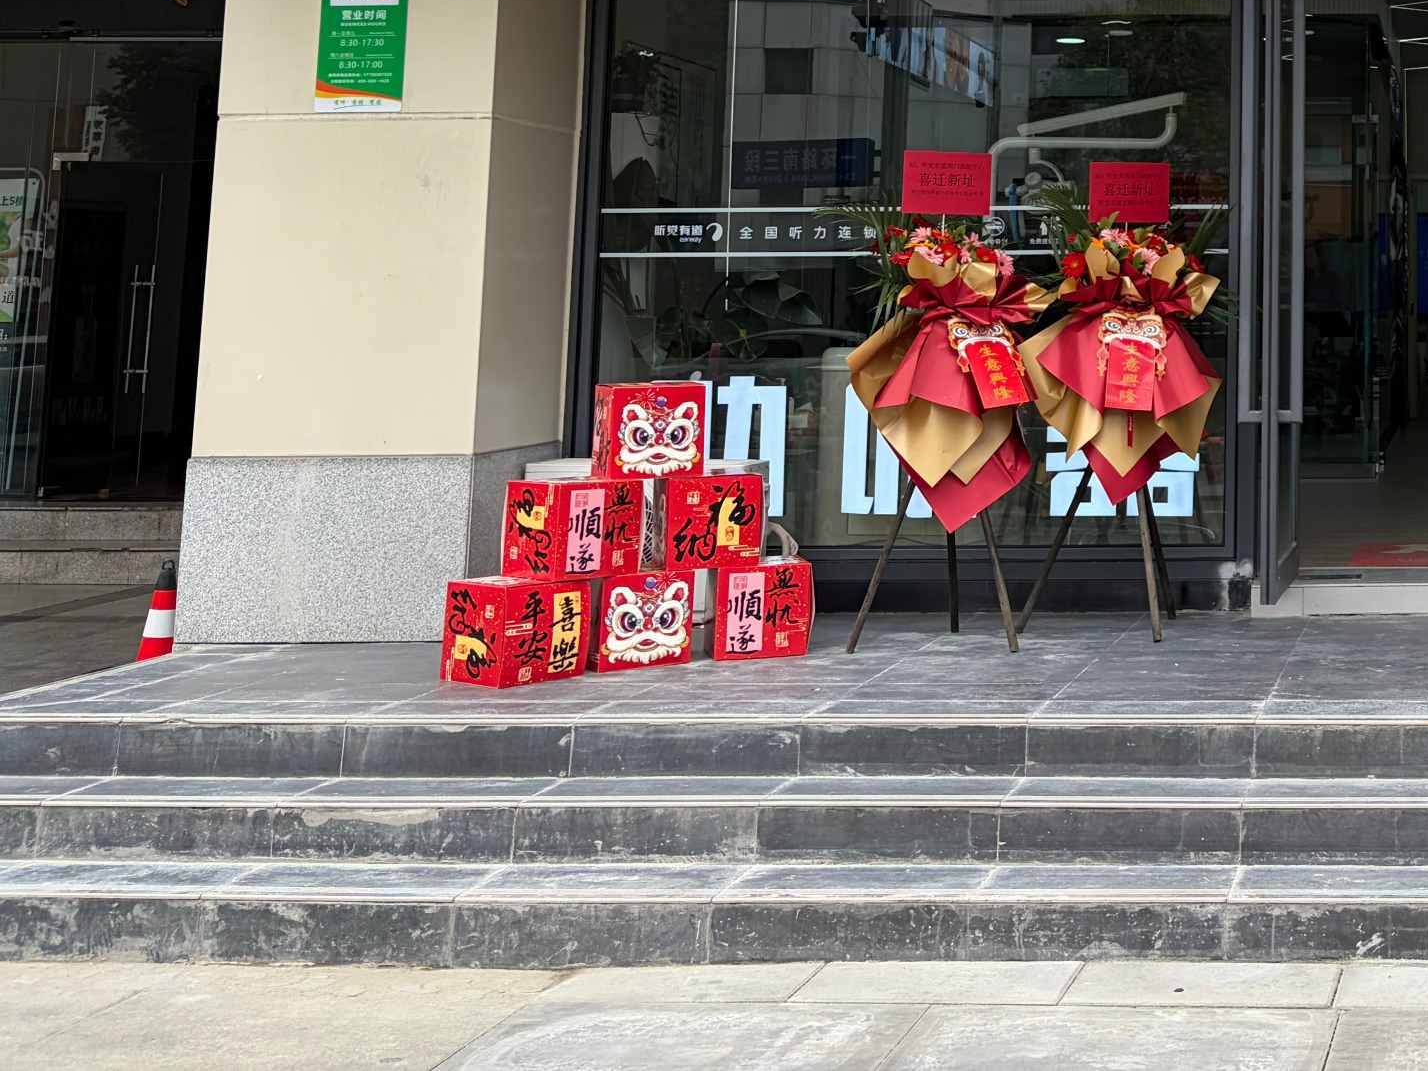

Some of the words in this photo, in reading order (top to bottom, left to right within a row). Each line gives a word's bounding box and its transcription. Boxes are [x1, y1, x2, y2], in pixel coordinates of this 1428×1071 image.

[342, 10, 387, 20] 营业时间
[654, 224, 703, 237] 听觉有道
[738, 225, 877, 240] 全国听力连锁
[514, 591, 548, 666] 平安
